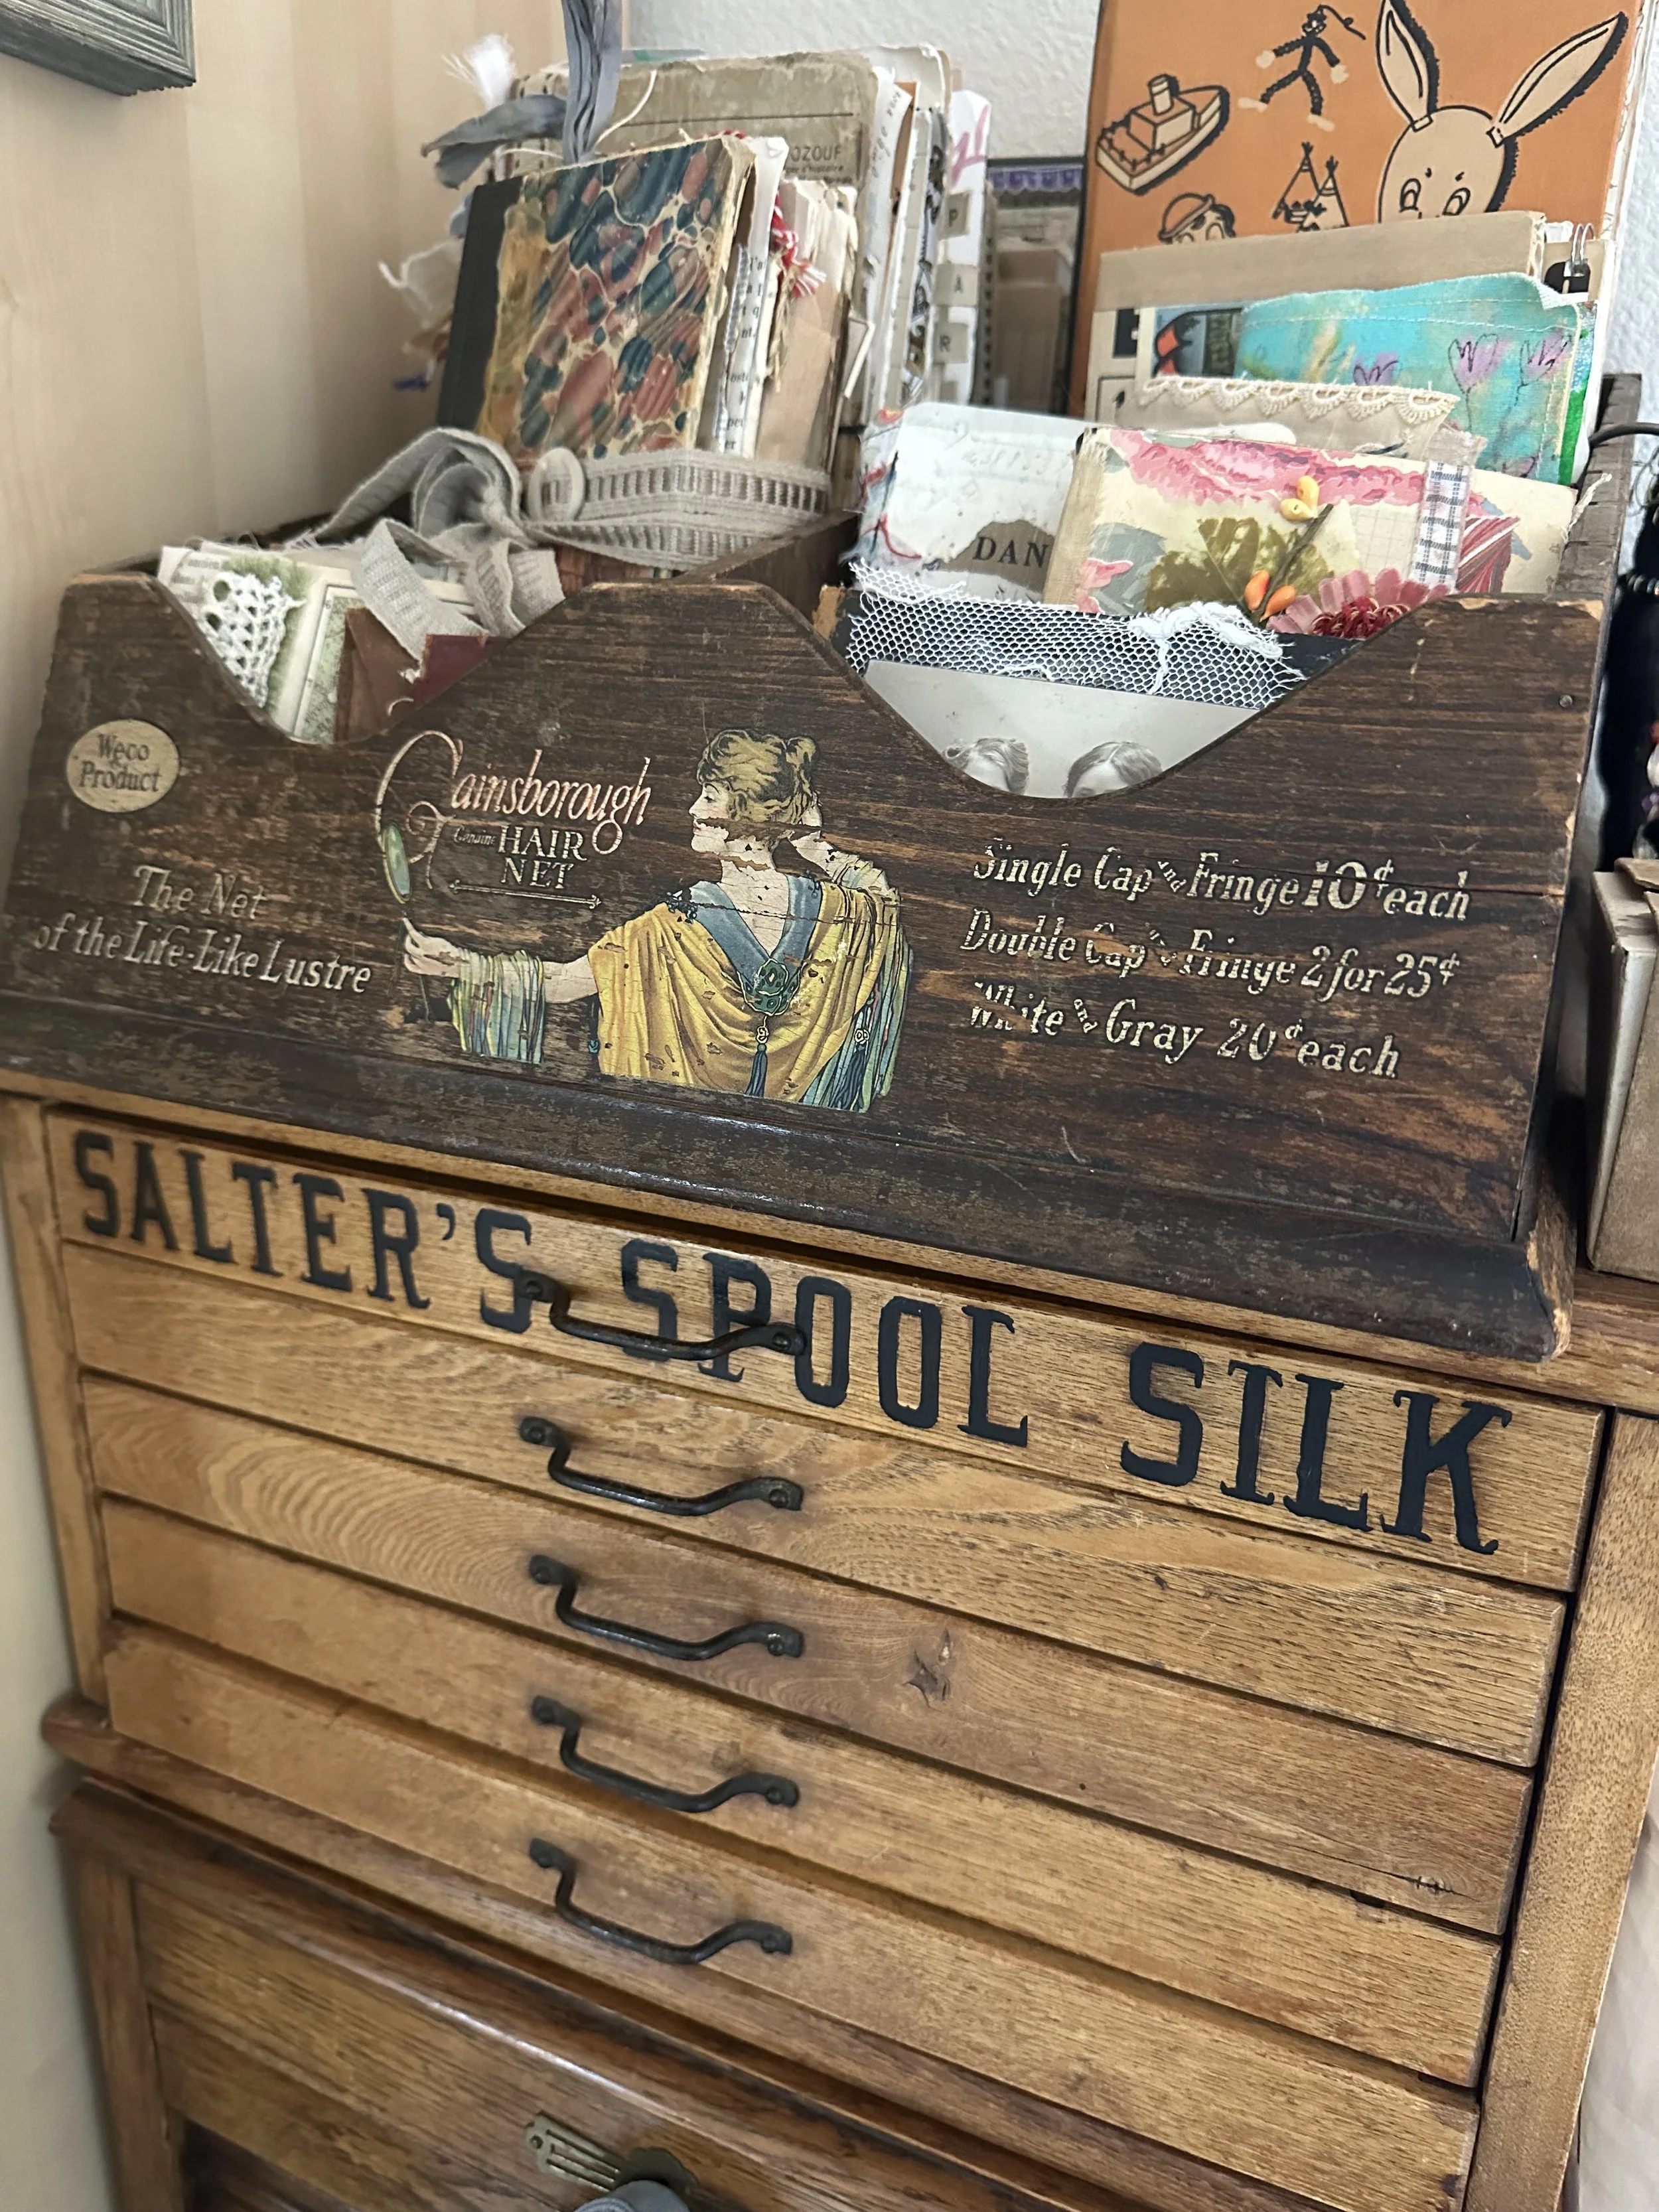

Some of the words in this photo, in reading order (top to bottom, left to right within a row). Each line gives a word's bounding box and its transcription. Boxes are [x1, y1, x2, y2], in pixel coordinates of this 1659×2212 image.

[972, 536, 1049, 569] DAN
[79, 760, 162, 792] Product
[375, 729, 652, 890] Gainsborough
[498, 824, 587, 861] HAIR
[501, 857, 574, 890] NET
[974, 838, 1082, 897] Single
[1094, 846, 1153, 901] Cap
[1187, 851, 1300, 916] Fringe
[1383, 870, 1471, 921] each
[132, 865, 194, 912] The
[201, 871, 267, 920] Net
[34, 913, 76, 951] of
[74, 917, 122, 959] the
[259, 938, 371, 994] Lustre
[960, 907, 1076, 961] Double
[1085, 922, 1145, 979] Cap
[1179, 928, 1296, 995] Fringe
[1300, 944, 1331, 988] 2
[1317, 947, 1386, 1003] for
[1384, 952, 1460, 999] 25¢
[1106, 998, 1204, 1063] Gray
[1297, 1034, 1400, 1079] each
[74, 1130, 532, 1333] SALTER'S
[620, 1238, 1028, 1447] SPOOL
[1120, 1341, 1512, 1555] SILK
